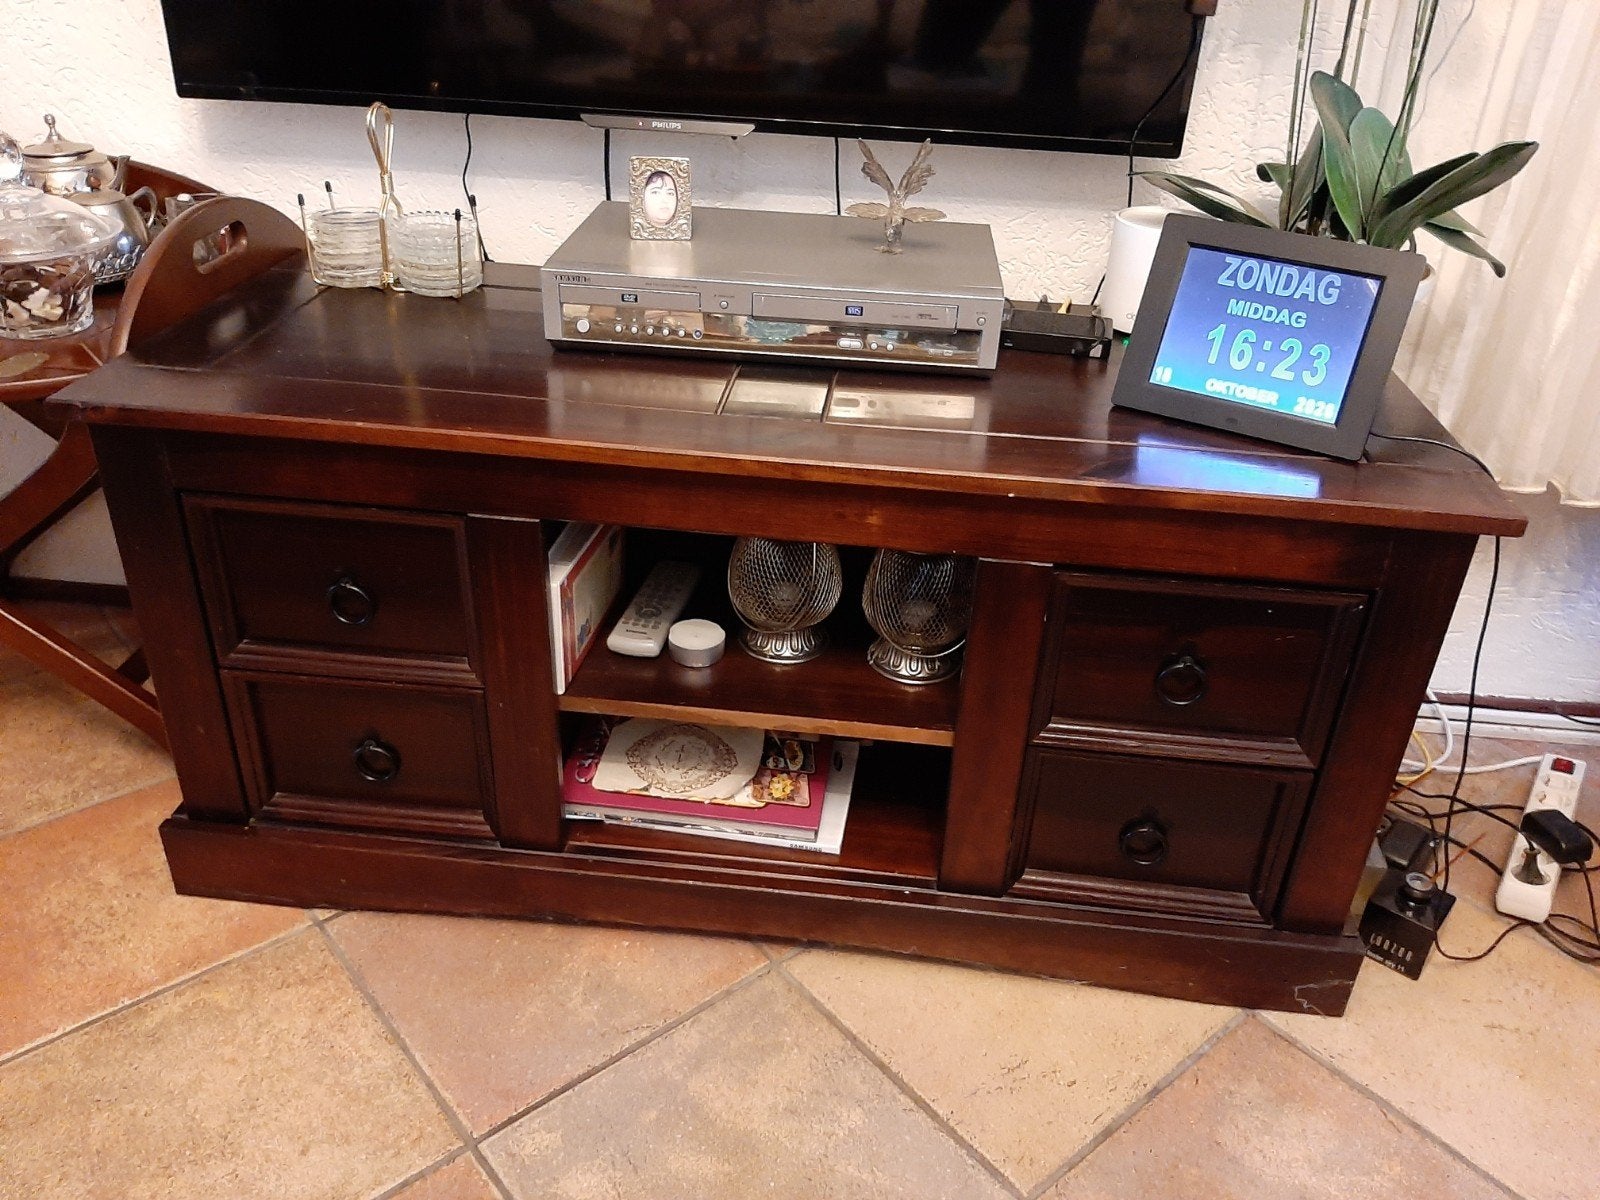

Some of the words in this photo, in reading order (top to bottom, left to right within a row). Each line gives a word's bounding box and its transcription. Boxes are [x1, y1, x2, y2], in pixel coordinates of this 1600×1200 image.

[652, 121, 682, 129] PHILIPS
[1217, 256, 1342, 305] ZONDAG
[1226, 298, 1308, 328] MIDDAG
[1207, 323, 1331, 387] 16:23
[1205, 378, 1279, 405] OKTOBER
